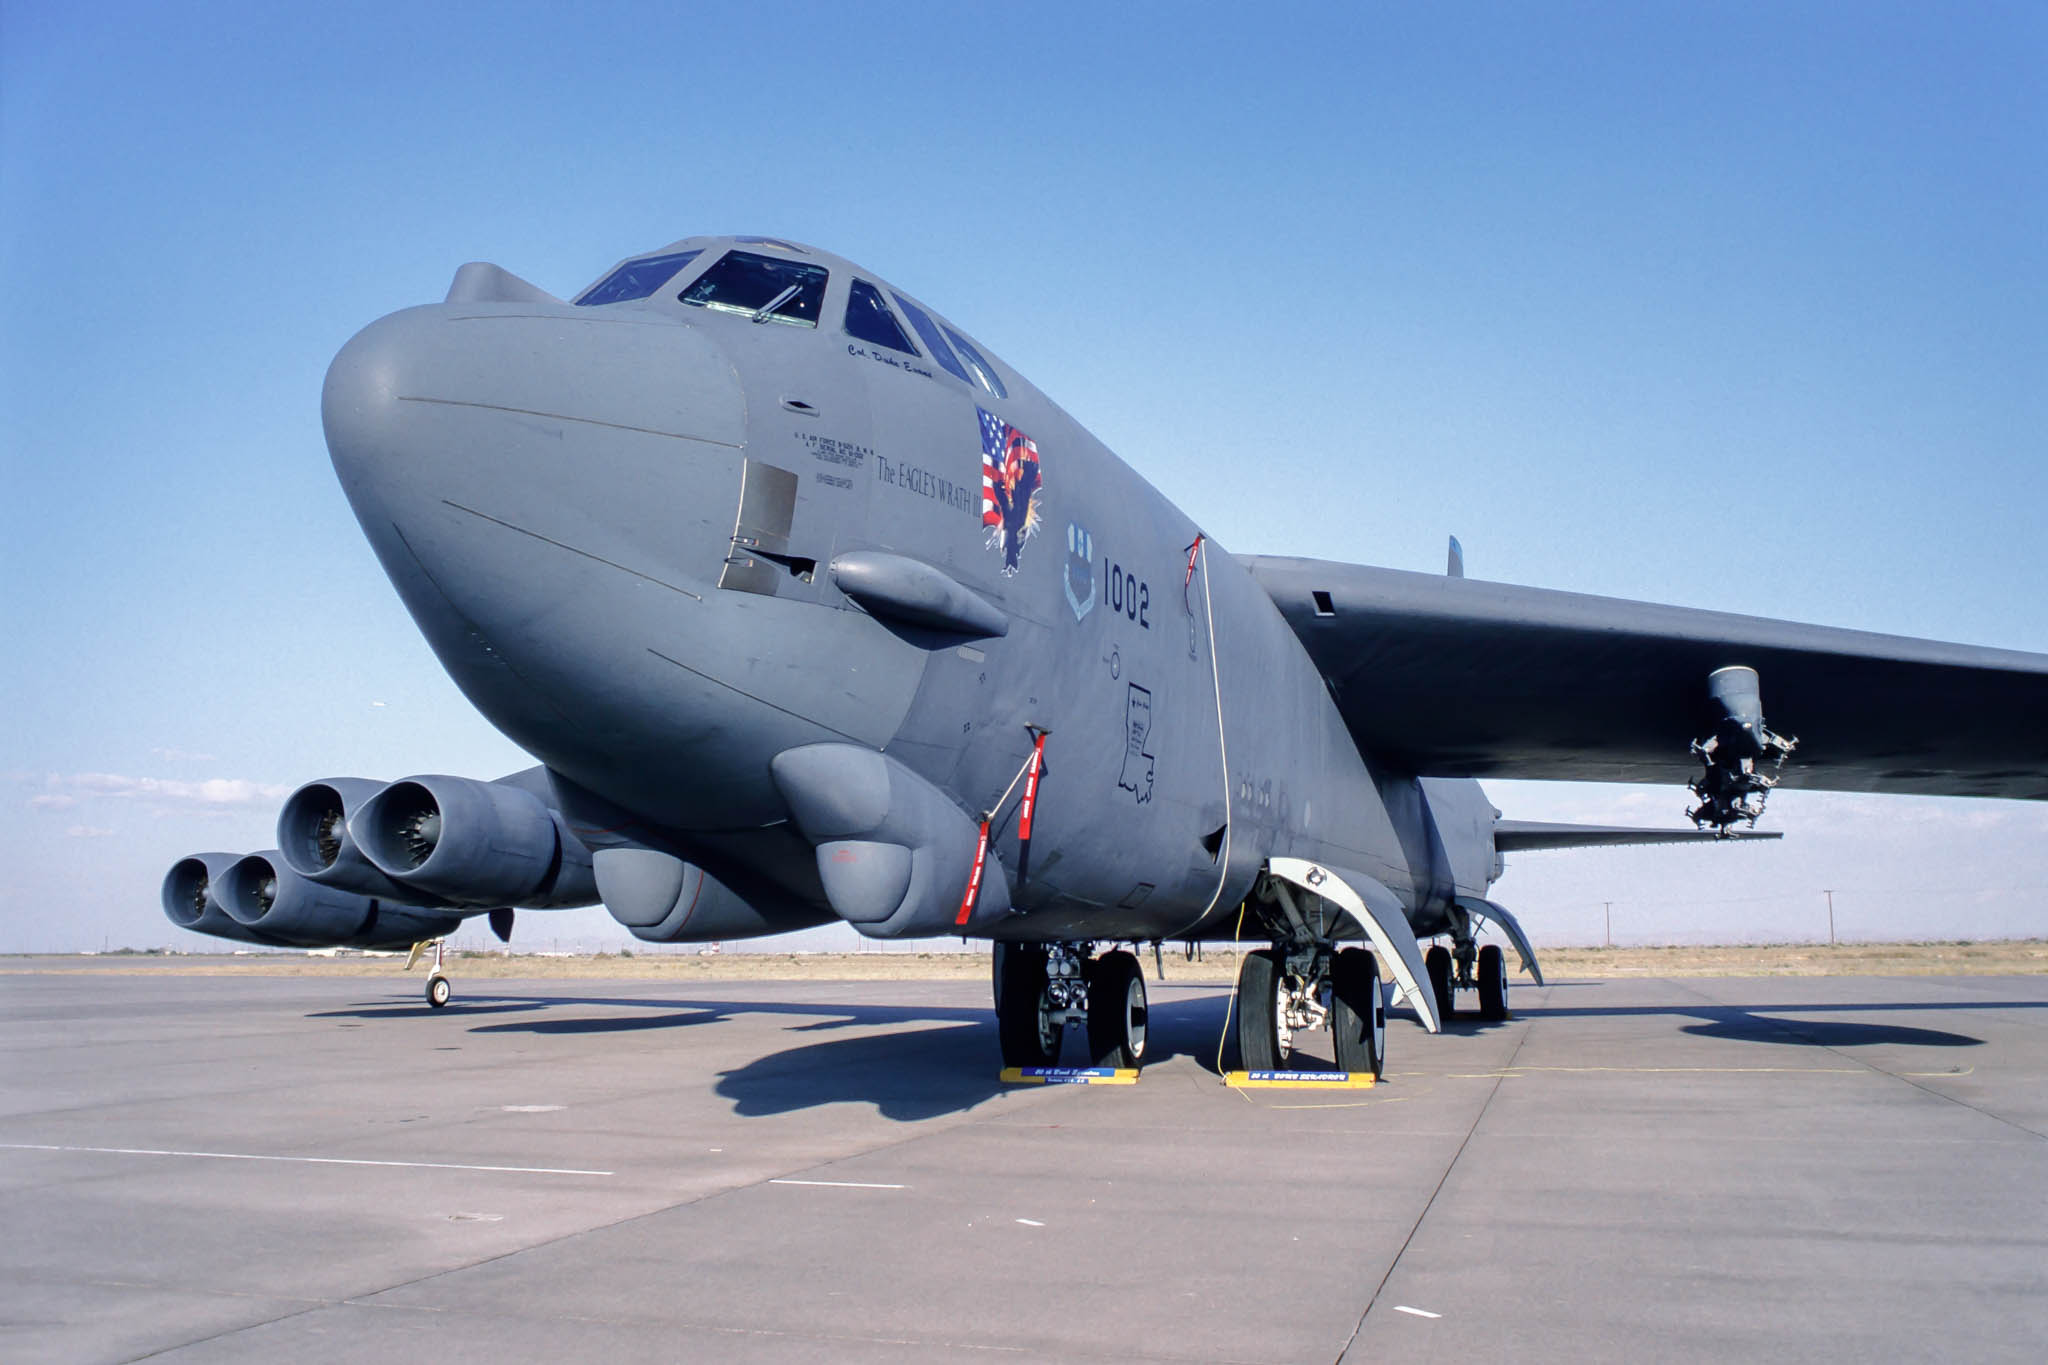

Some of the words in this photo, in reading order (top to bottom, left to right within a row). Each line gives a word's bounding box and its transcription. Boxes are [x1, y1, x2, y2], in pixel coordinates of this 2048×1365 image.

[877, 455, 896, 484] The
[938, 478, 971, 514] WRATH
[1104, 557, 1149, 630] 1002
